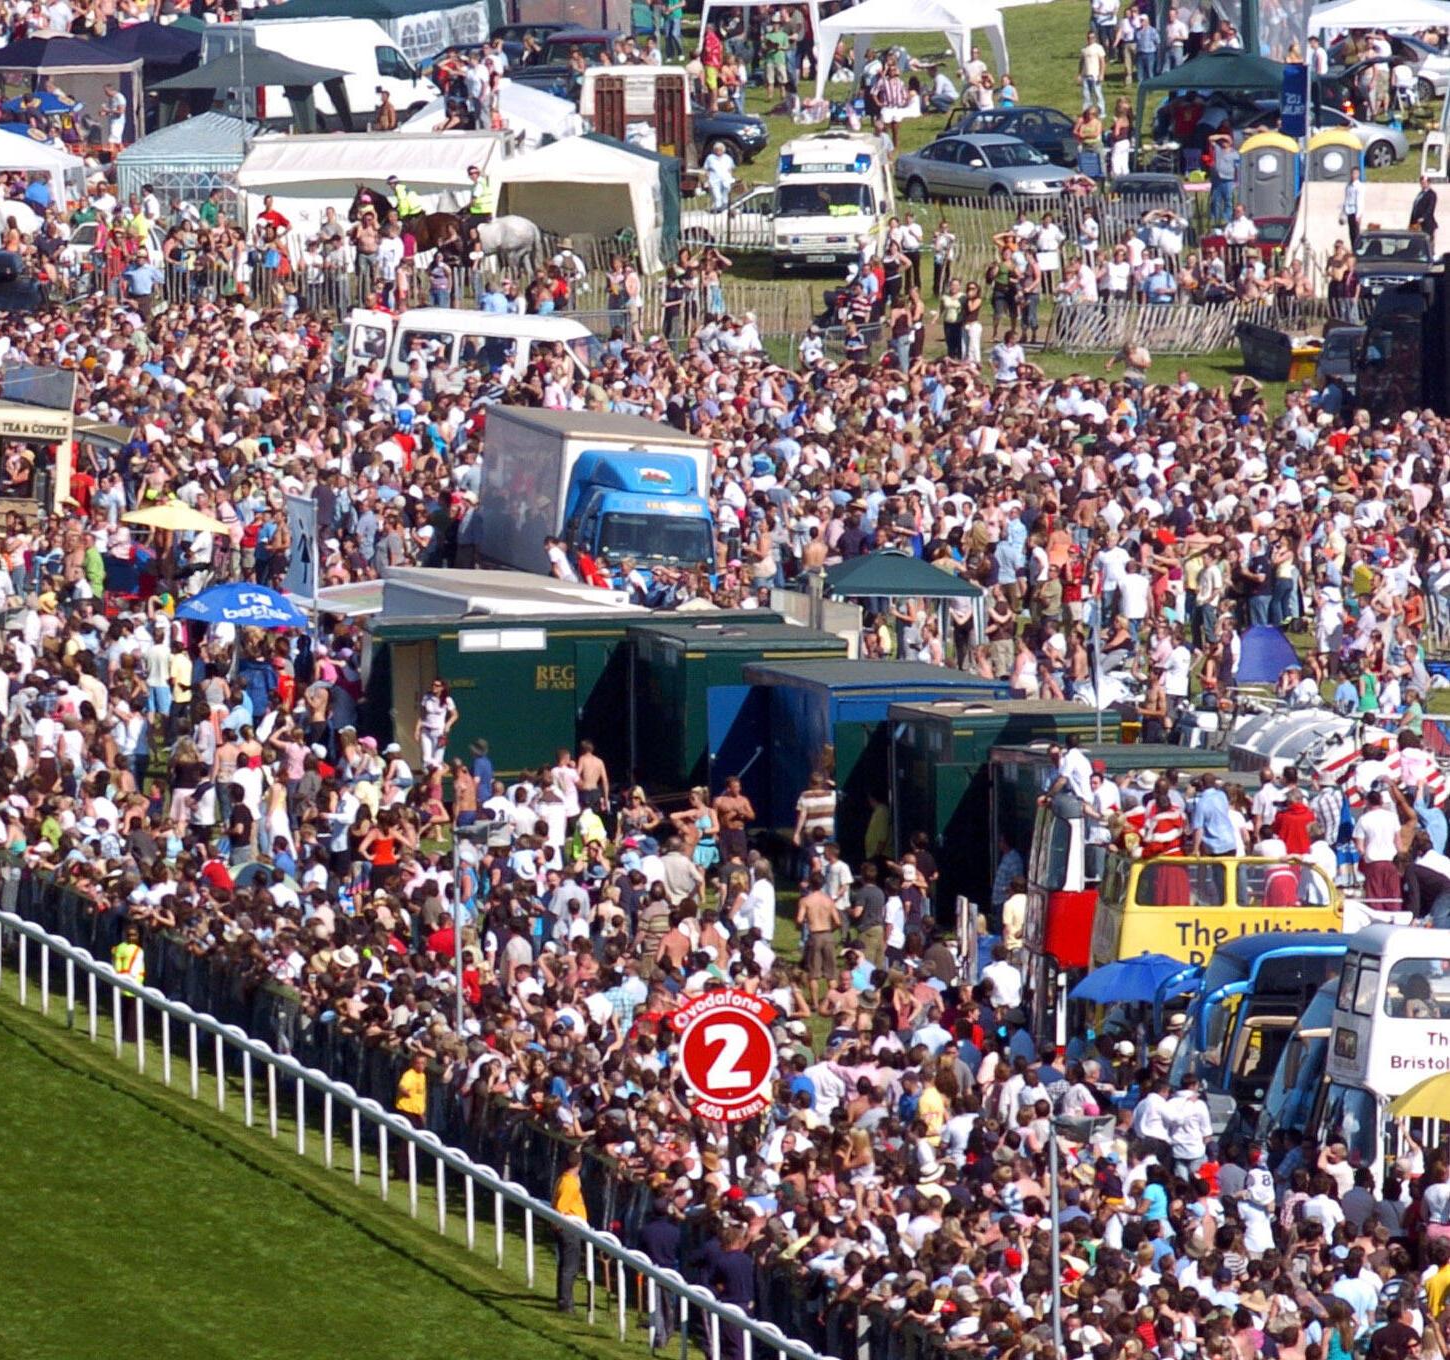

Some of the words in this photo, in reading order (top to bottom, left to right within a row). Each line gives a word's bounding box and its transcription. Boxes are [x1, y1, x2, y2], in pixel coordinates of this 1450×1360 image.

[3, 422, 20, 433] TEA
[31, 424, 68, 436] COFFEE
[535, 665, 575, 681] REG
[1175, 918, 1228, 946] The
[685, 989, 762, 1018] vodafone
[704, 1023, 752, 1090] 2
[1390, 1055, 1450, 1070] Bristol
[696, 1102, 724, 1120] 400
